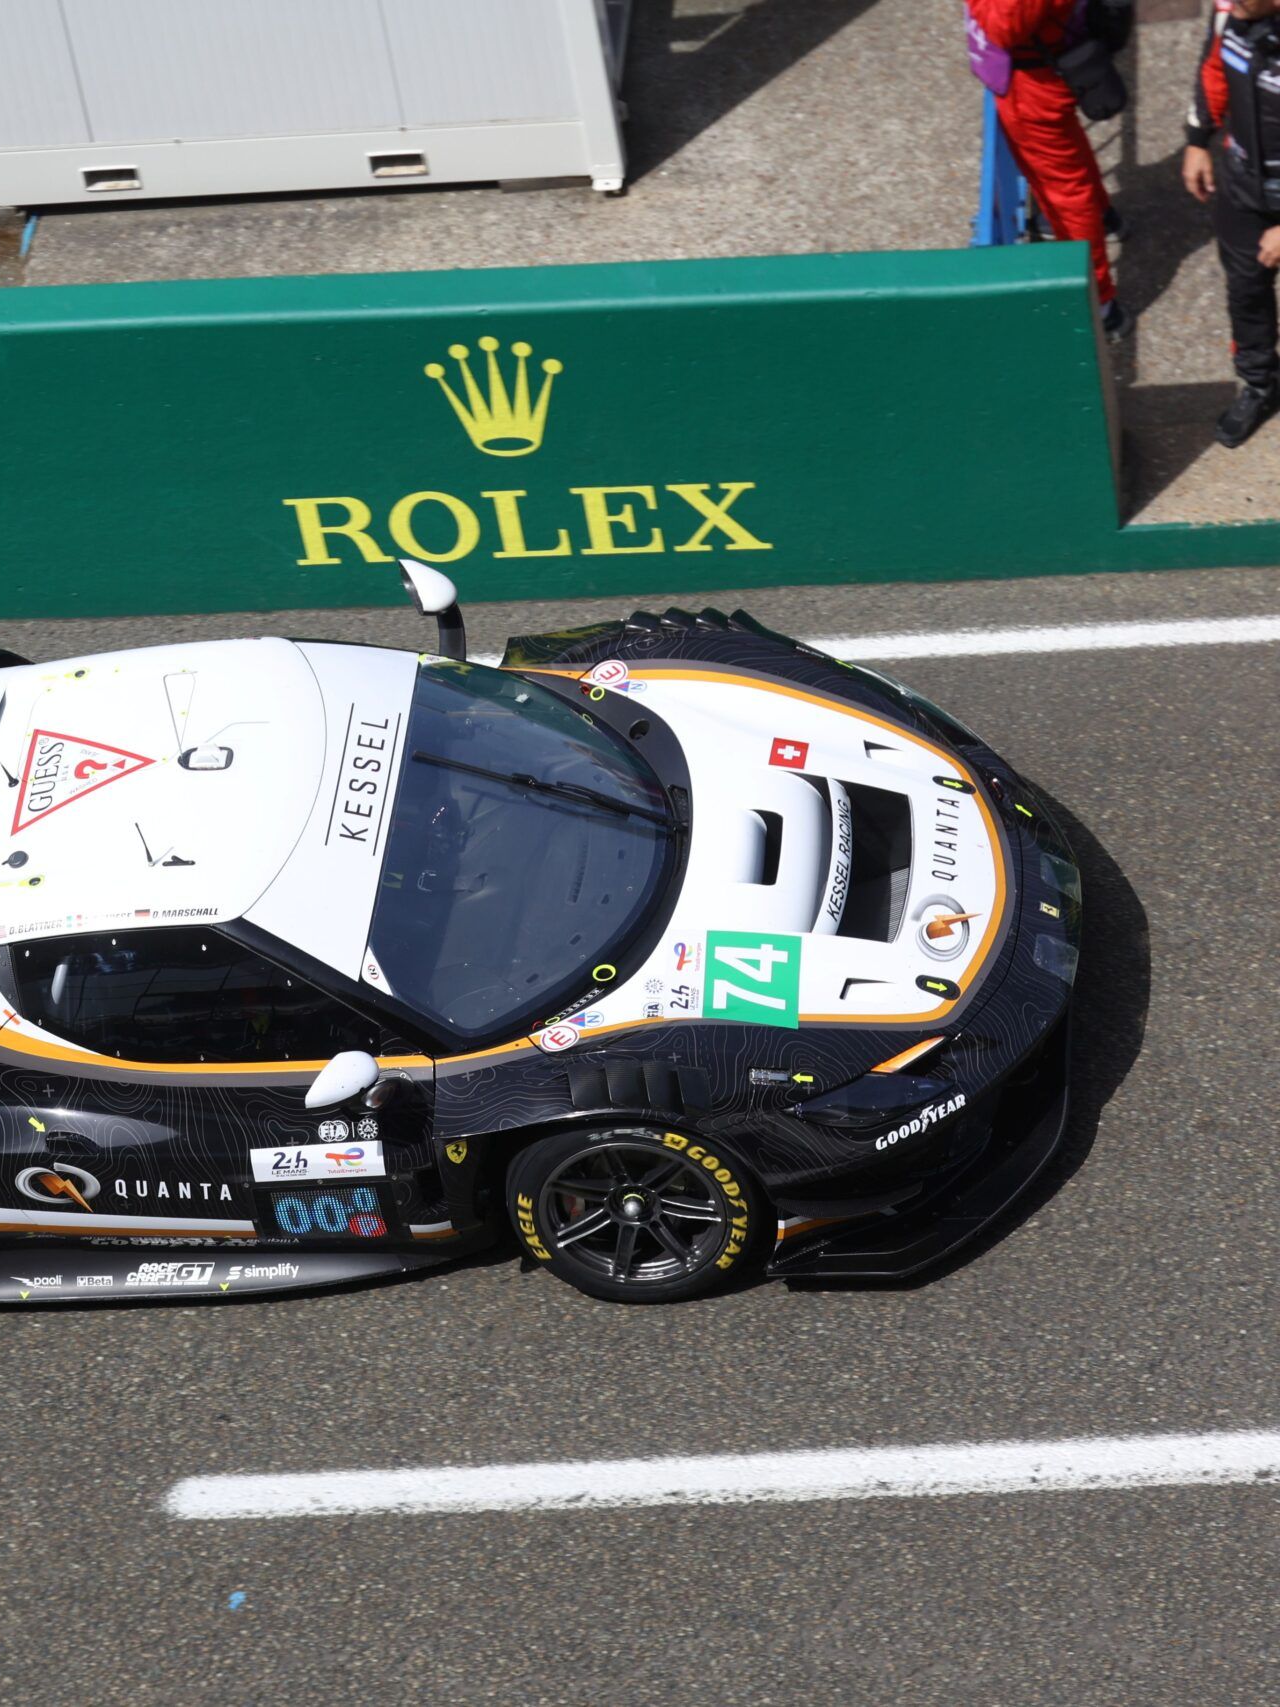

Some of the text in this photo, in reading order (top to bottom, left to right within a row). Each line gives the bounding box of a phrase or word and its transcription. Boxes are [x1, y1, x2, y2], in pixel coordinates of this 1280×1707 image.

[282, 482, 774, 566] ROLEX
[27, 742, 65, 812] GUESS
[339, 718, 389, 842] KESSEL
[932, 798, 960, 881] QUANTA
[826, 799, 852, 922] KESSEL RACING
[670, 984, 690, 1010] 24h
[712, 943, 789, 1011] 74
[320, 1123, 347, 1139] FIA
[875, 1093, 966, 1150] GOODYEAR
[272, 1151, 308, 1170] 24h
[114, 1178, 233, 1201] QUANTA
[686, 1145, 748, 1269] GOODYEAR
[517, 1191, 552, 1260] EAGLE
[33, 1274, 62, 1288] paoli
[88, 1277, 112, 1286] Beta
[126, 1272, 176, 1282] CRAFT
[176, 1263, 214, 1281] GT
[244, 1263, 300, 1279] simplify
